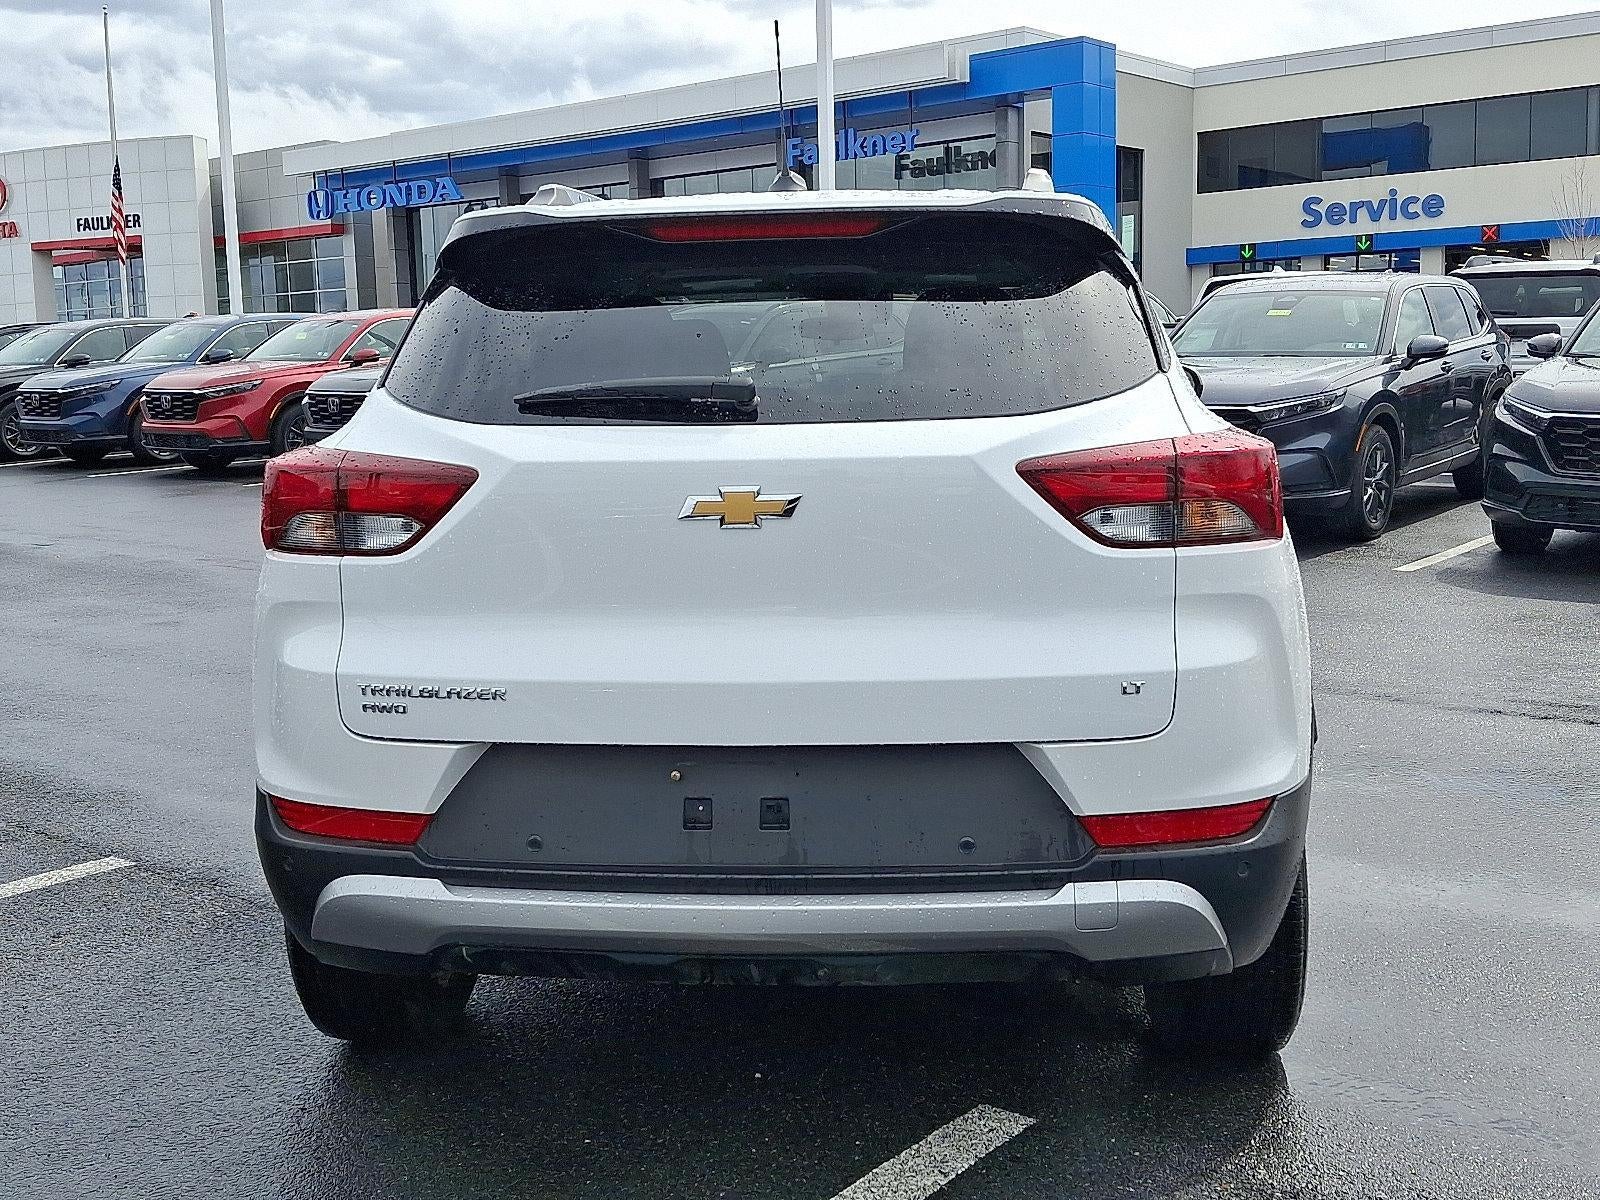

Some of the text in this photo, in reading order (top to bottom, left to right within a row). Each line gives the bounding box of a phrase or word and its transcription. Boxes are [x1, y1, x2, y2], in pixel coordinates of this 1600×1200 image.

[787, 128, 919, 168] Falkner
[333, 176, 463, 214] HONDA
[1300, 187, 1445, 229] Service
[76, 213, 142, 233] FAULKER
[357, 683, 507, 701] TRAILBLAZER
[1121, 681, 1146, 695] LT
[361, 701, 408, 715] AWD
